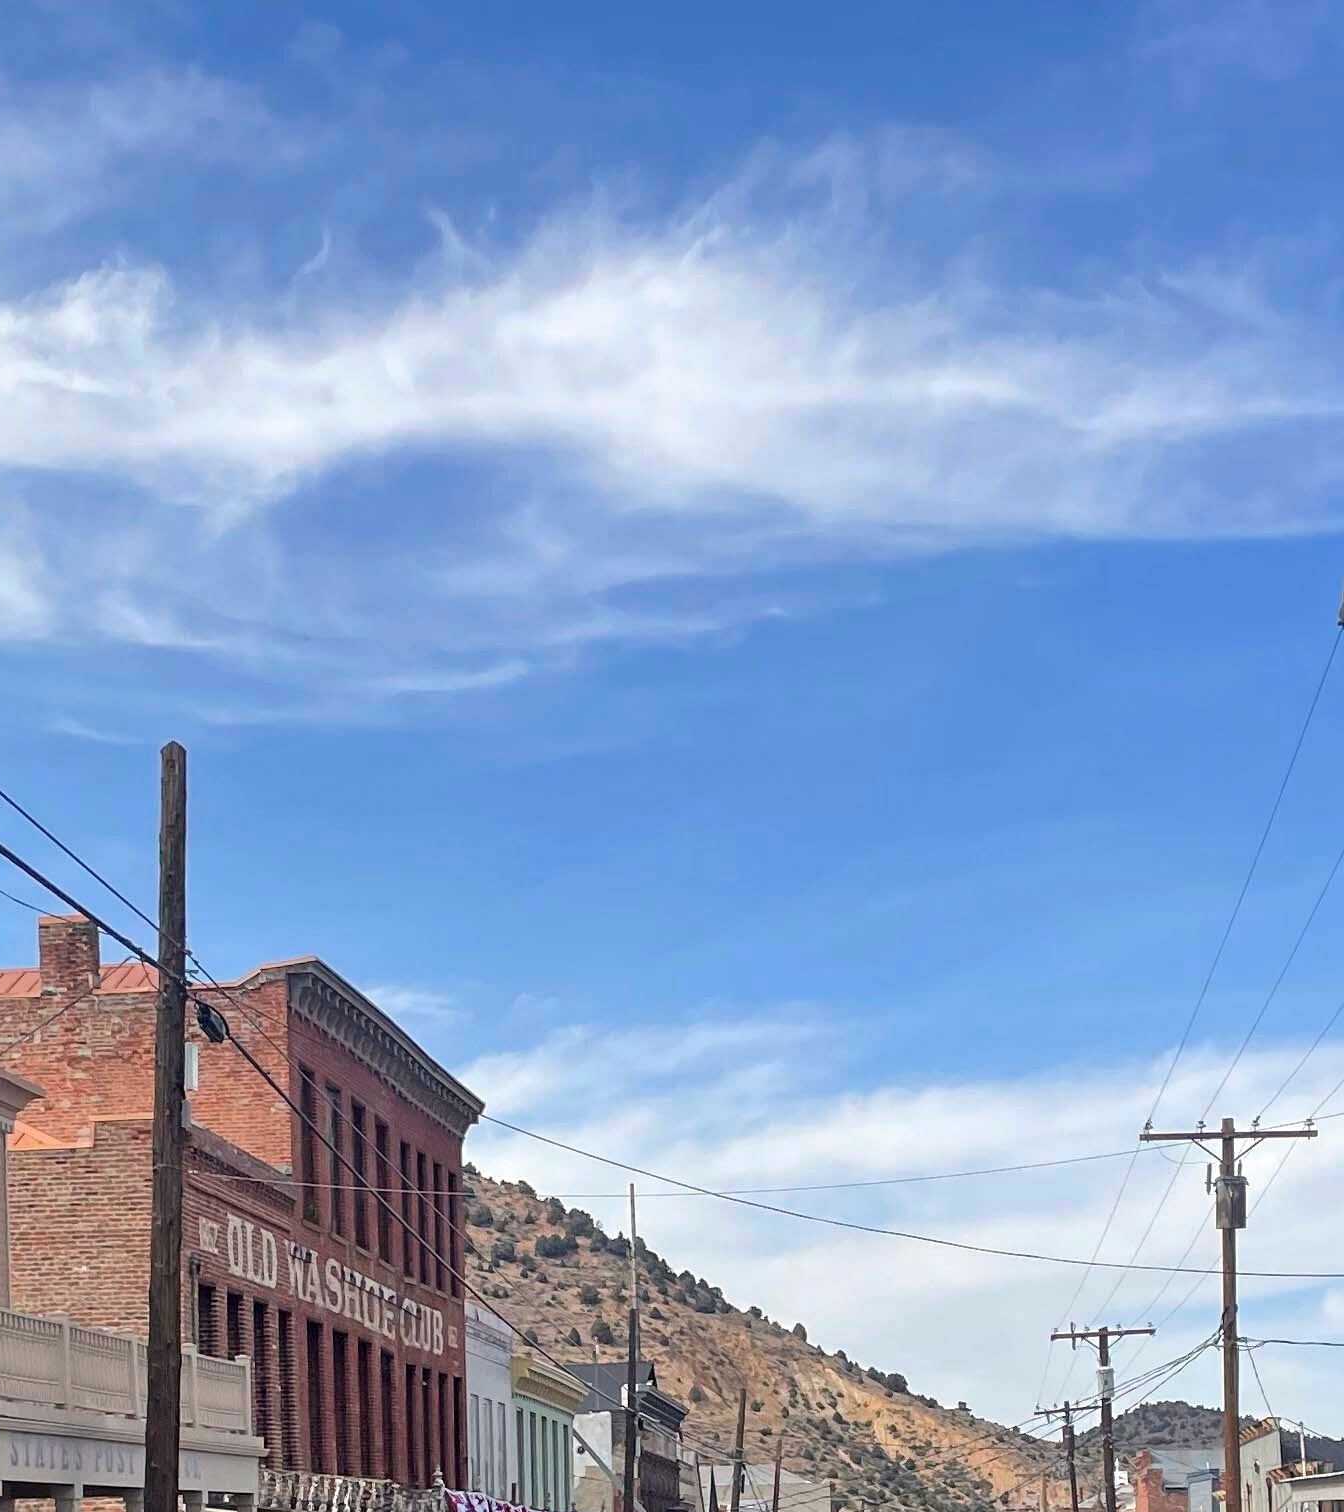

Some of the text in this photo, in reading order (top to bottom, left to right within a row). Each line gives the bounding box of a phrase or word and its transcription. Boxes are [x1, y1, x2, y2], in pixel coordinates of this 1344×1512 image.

[226, 1212, 278, 1290] OLD
[286, 1238, 398, 1342] WASHOE
[399, 1297, 445, 1356] CLUB
